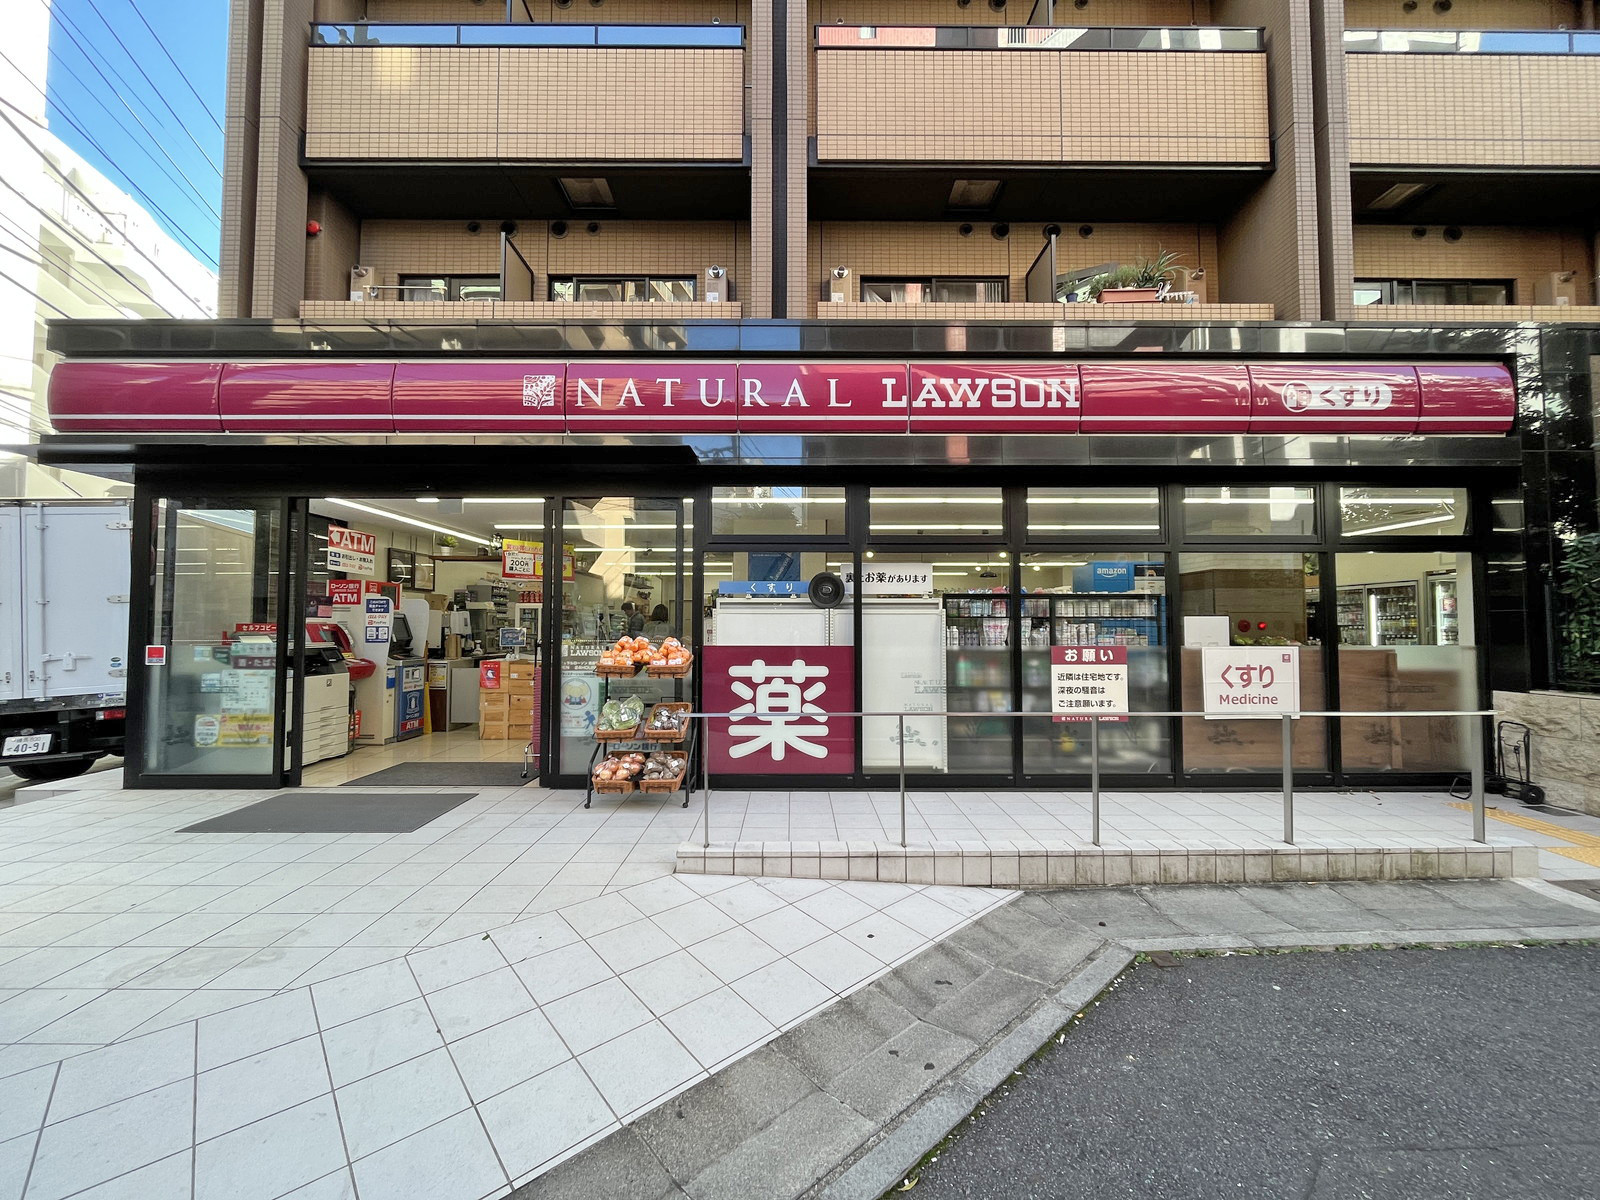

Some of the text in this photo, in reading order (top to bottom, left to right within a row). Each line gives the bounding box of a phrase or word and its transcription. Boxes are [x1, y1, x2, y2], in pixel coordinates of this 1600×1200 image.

[576, 377, 1079, 409] NATURAL LAWSON
[1319, 385, 1380, 407] くすり
[340, 530, 375, 553] ATM
[1096, 567, 1127, 577] amazon
[845, 572, 928, 584] 裏お薬があります
[750, 582, 794, 593] くすり
[332, 593, 357, 603] ATM
[1064, 648, 1114, 662] お願い
[1057, 672, 1124, 682] 近隣は住宅地です。
[1220, 664, 1275, 689] くすり
[1057, 686, 1106, 695] 深夜の騒音は
[1058, 699, 1117, 708] ご注意願います。
[1219, 693, 1279, 705] Medicine
[727, 659, 830, 762] 薬
[405, 719, 419, 730] ATM
[13, 742, 46, 753] 40-91
